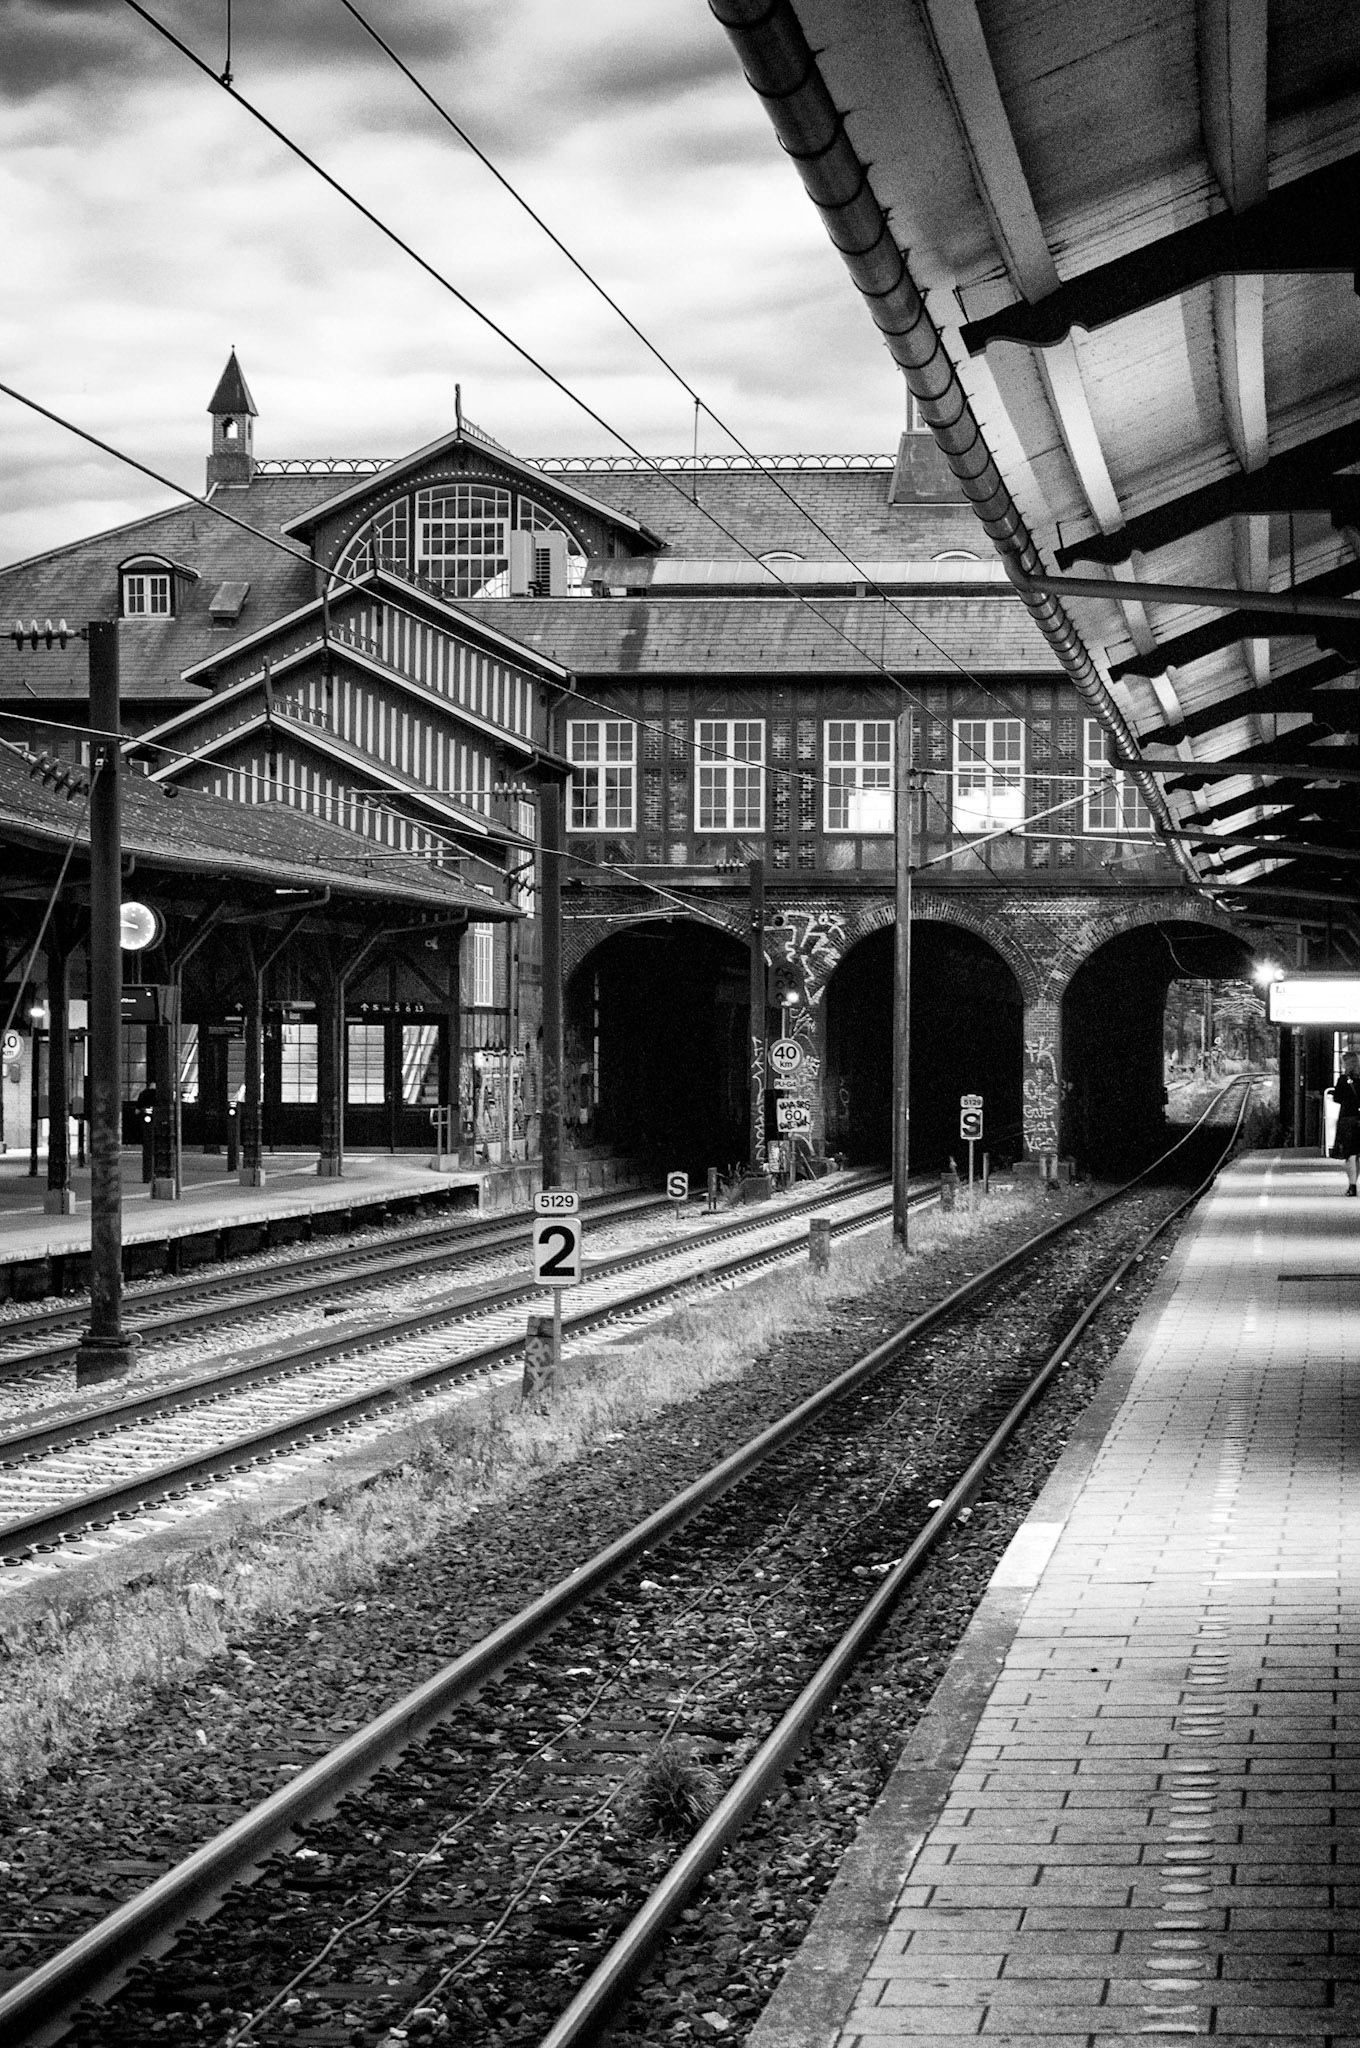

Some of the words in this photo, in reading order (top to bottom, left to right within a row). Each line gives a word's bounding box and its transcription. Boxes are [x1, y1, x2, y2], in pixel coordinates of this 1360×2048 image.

[774, 1046, 797, 1060] 40
[785, 1110, 802, 1121] 60
[962, 1112, 981, 1136] S
[668, 1175, 687, 1198] S
[540, 1195, 574, 1208] 5129
[538, 1225, 575, 1277] 2
